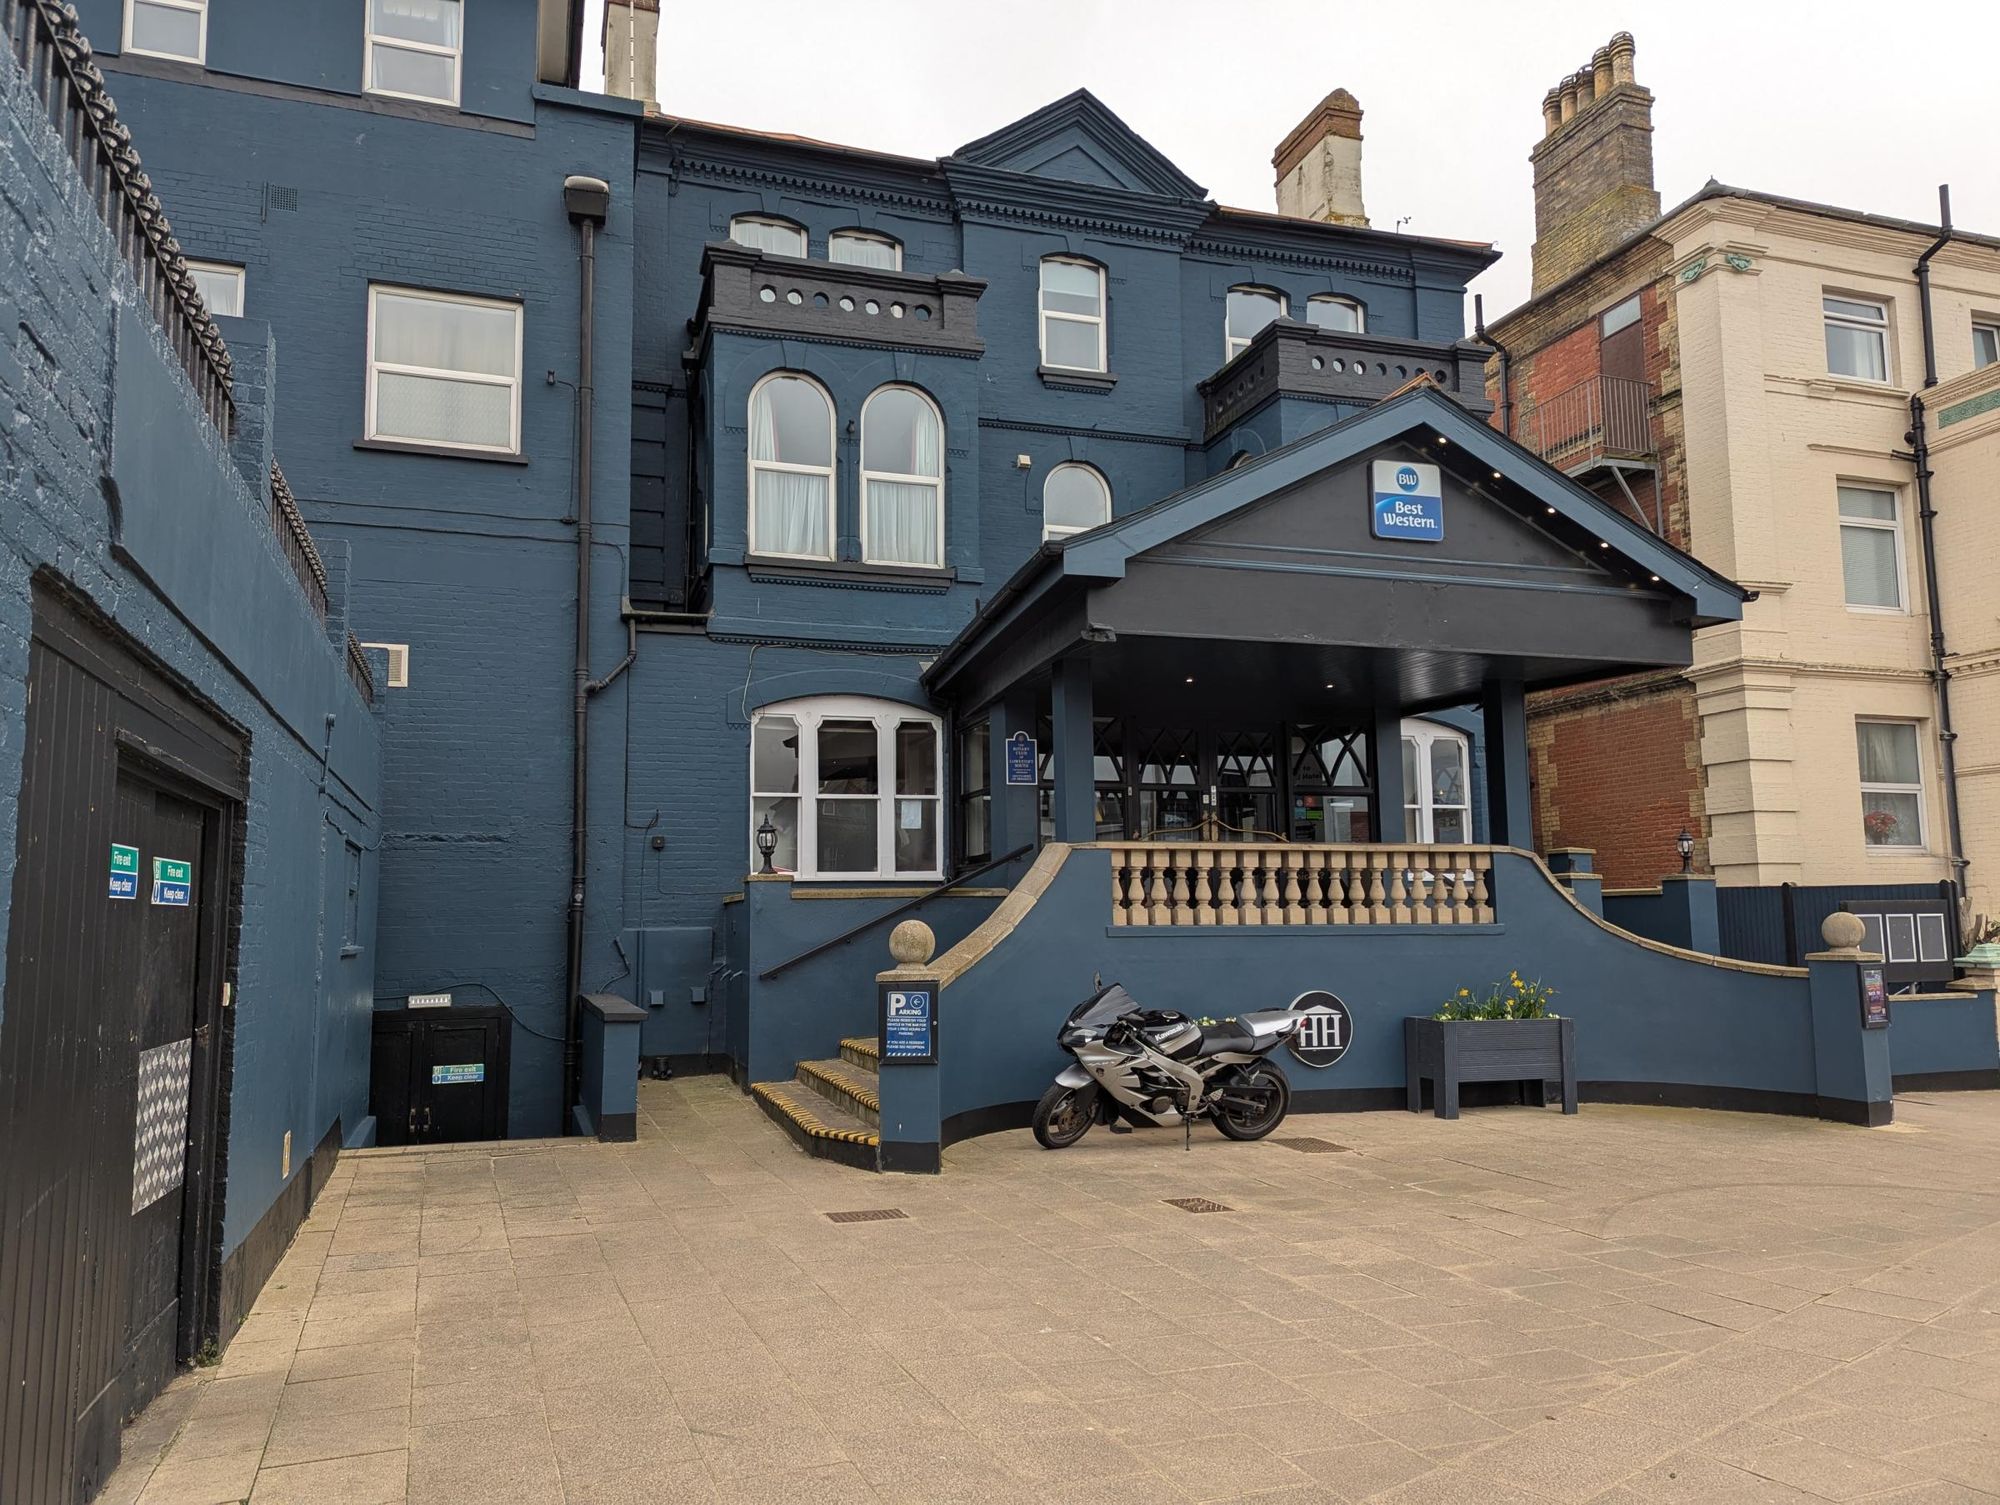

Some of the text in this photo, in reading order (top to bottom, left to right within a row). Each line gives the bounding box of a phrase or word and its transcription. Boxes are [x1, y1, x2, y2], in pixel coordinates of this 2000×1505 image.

[1398, 473, 1417, 486] BW
[1395, 501, 1424, 516] Best
[1383, 512, 1435, 528] Western
[113, 851, 131, 866] Fire exit
[167, 865, 175, 877] Fire
[110, 877, 133, 894] Keep clear
[163, 887, 185, 901] Keep clear
[1154, 1023, 1184, 1042] Kawasaki
